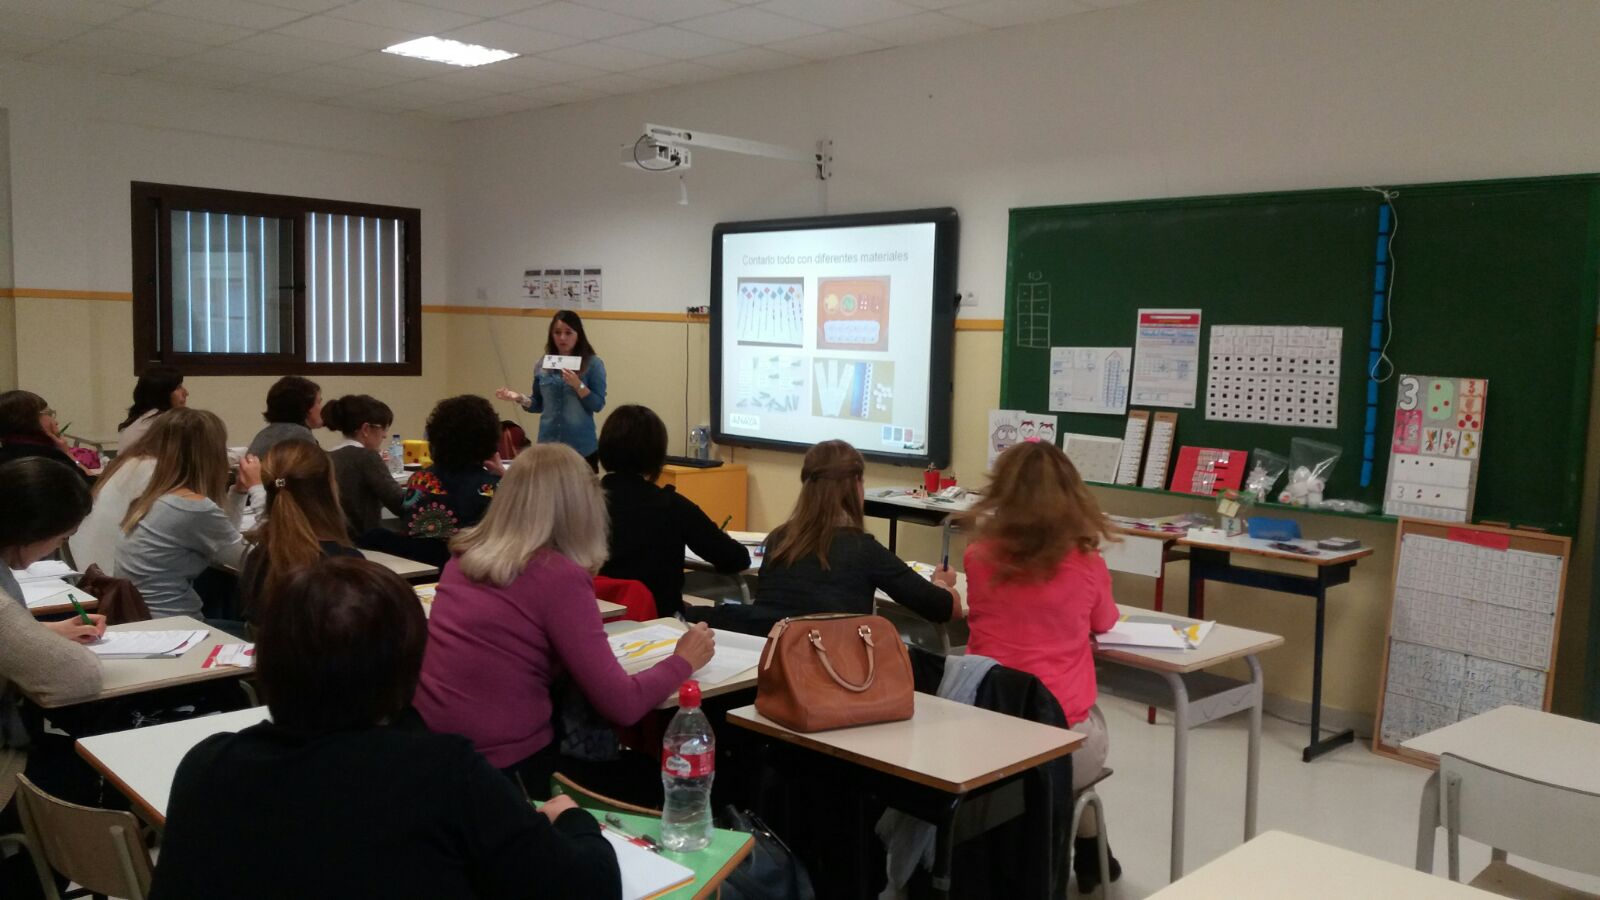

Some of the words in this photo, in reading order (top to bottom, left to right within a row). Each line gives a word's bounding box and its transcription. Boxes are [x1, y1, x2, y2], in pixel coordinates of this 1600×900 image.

[742, 254, 775, 265] Contarlo
[776, 254, 796, 265] todo
[797, 255, 813, 265] con
[814, 252, 858, 264] diferentes
[860, 250, 909, 263] materiales
[1399, 377, 1419, 411] 3
